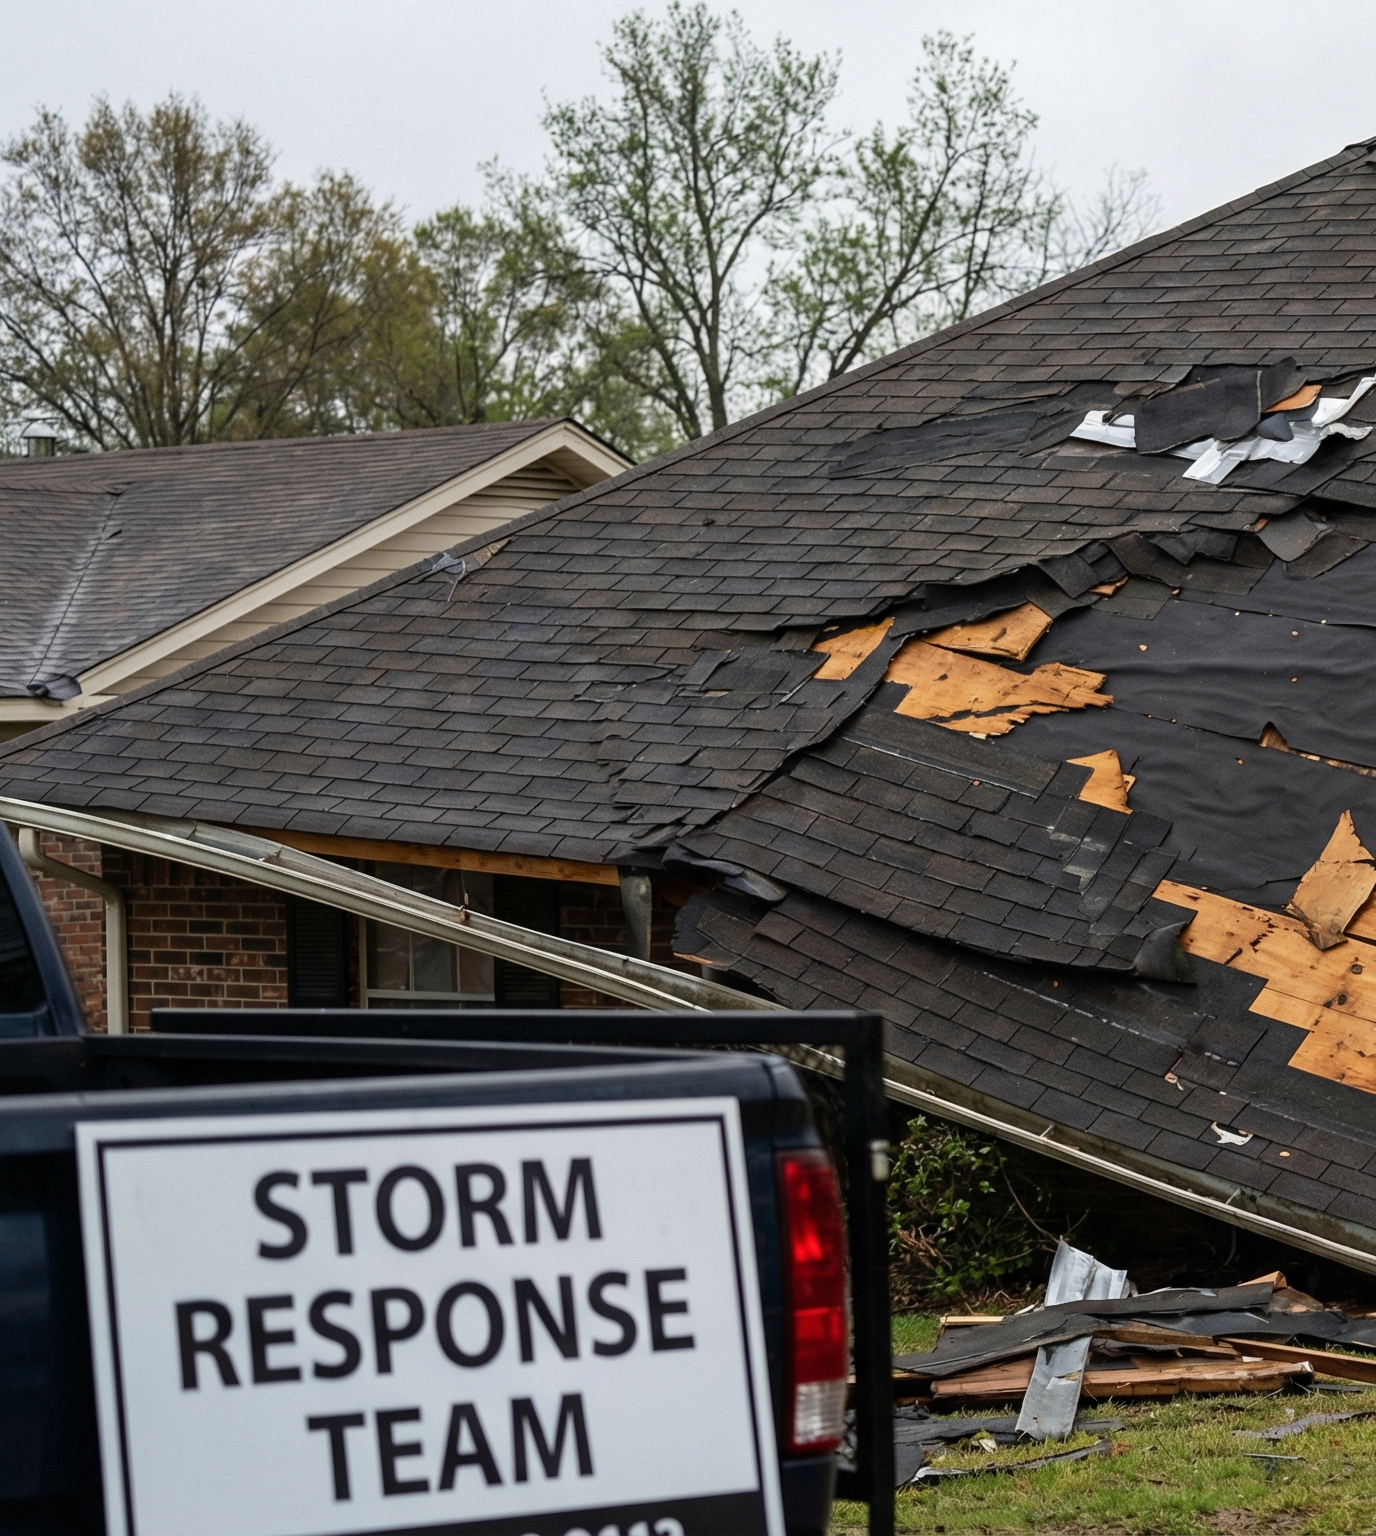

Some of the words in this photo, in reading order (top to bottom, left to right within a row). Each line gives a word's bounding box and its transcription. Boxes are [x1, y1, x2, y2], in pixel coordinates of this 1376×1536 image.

[253, 1156, 603, 1261] STORM
[174, 1267, 696, 1392] RESPONSE
[306, 1392, 595, 1503] TEAM
